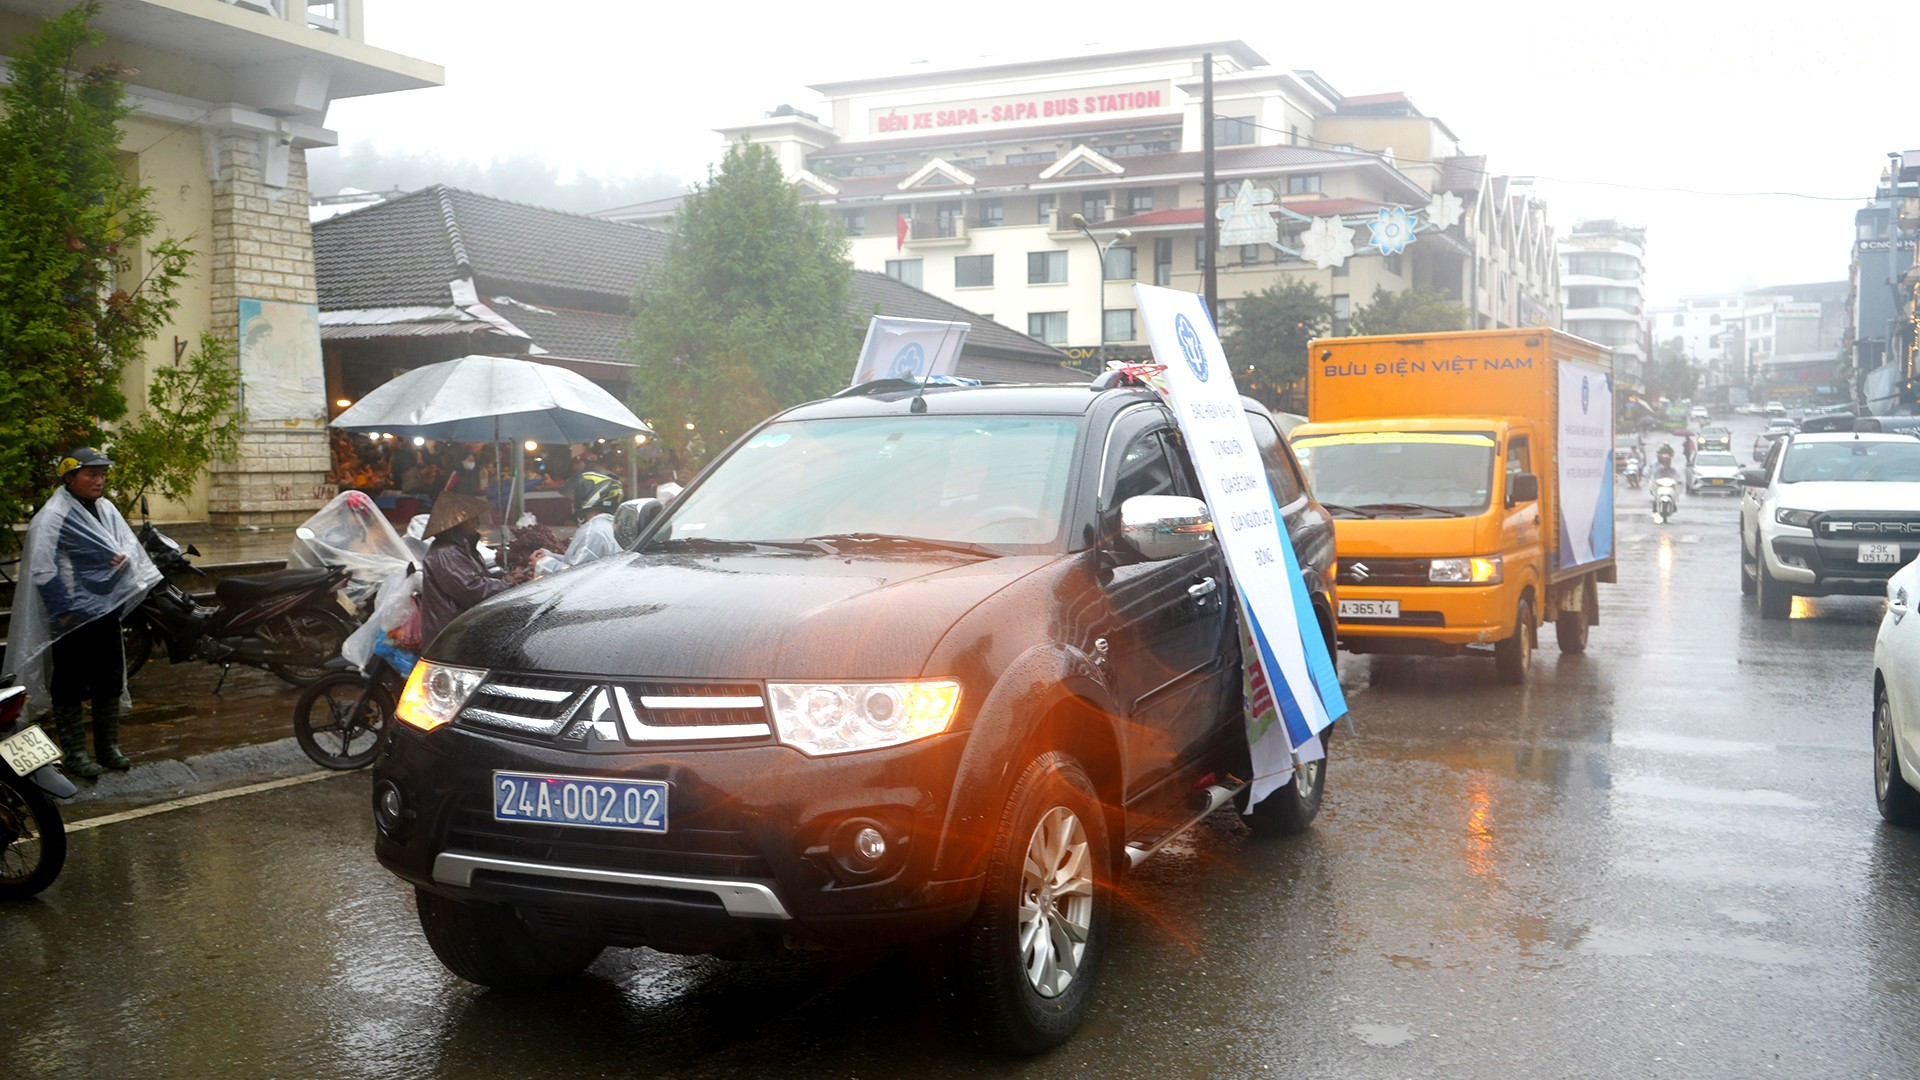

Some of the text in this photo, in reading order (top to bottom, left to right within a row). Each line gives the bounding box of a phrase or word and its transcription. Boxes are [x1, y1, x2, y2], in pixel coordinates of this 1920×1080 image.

[878, 108, 908, 132] BẾN
[913, 112, 933, 130] XE
[936, 108, 979, 127] SAPA
[991, 102, 1038, 121] SAPA
[1043, 98, 1079, 118] BUS
[1084, 90, 1161, 114] STATION
[1374, 357, 1425, 377] ĐIỆN
[1431, 355, 1478, 375] VIỆT
[1484, 357, 1533, 371] NAM
[1862, 554, 1896, 563] 051.71
[12, 743, 57, 772] 963.33
[500, 779, 660, 826] 24A-002.02
